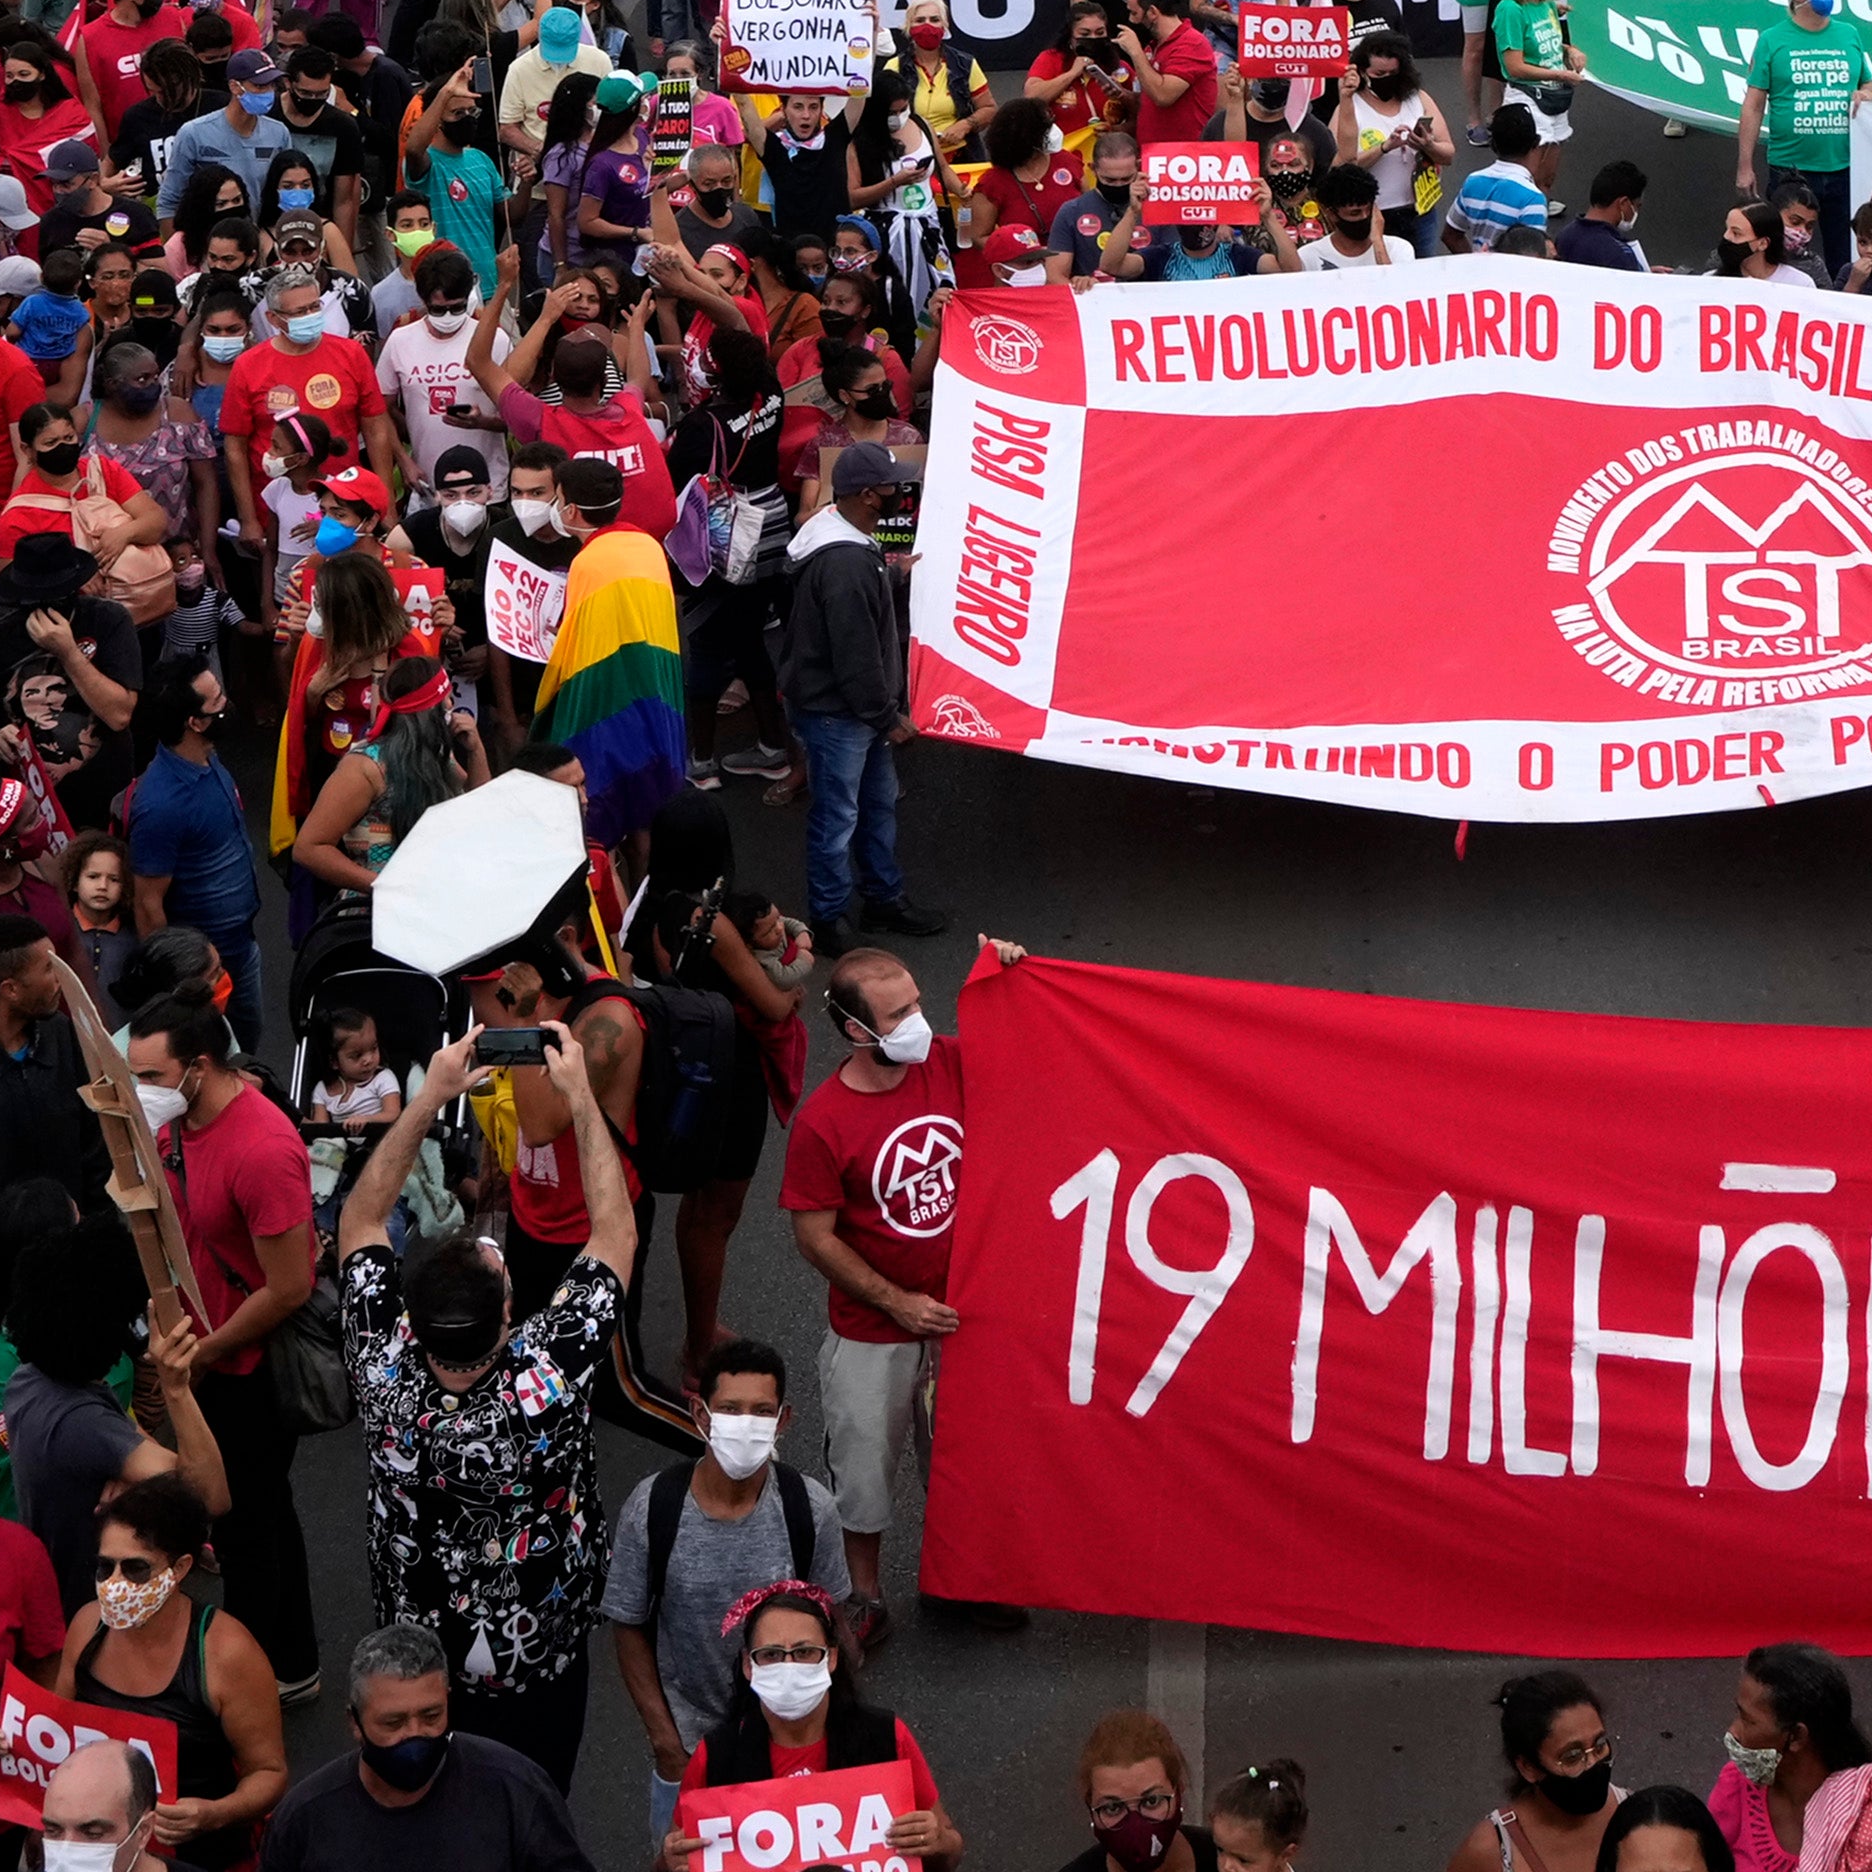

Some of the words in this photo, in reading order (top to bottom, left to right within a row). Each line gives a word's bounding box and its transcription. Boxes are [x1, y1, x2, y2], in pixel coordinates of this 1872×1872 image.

[730, 18, 848, 43] VERGONHA
[1242, 14, 1343, 45] FORA
[1242, 42, 1344, 60] BOLSONARO
[1790, 54, 1849, 74] floresta
[749, 52, 859, 81] MUNDIAL
[1274, 63, 1310, 75] CUT
[1790, 71, 1817, 85] em
[1822, 67, 1849, 85] pé
[1815, 100, 1849, 115] puro
[1793, 114, 1849, 129] comida
[1149, 155, 1248, 182] FORA
[1149, 183, 1253, 203] BOLSONARO
[1180, 206, 1216, 221] CUT
[1110, 288, 1560, 384] REVOLUCIONARIO
[1593, 302, 1663, 374] DO
[409, 362, 471, 385] ASICS
[970, 399, 1052, 501] PISA
[1546, 454, 1632, 577] MOVIMENTO
[1630, 430, 1683, 477] DOS
[954, 502, 1042, 668] LIGEIRO
[1550, 604, 1584, 647] NA
[1573, 629, 1646, 690] LUTA
[1646, 668, 1721, 708] PELA
[1719, 664, 1866, 708] REFORMA
[1680, 635, 1842, 661] BRASIL
[1517, 741, 1555, 790] O
[1598, 729, 1786, 793] PODER
[1049, 1147, 1256, 1418] 19
[698, 1790, 895, 1872] FORA
